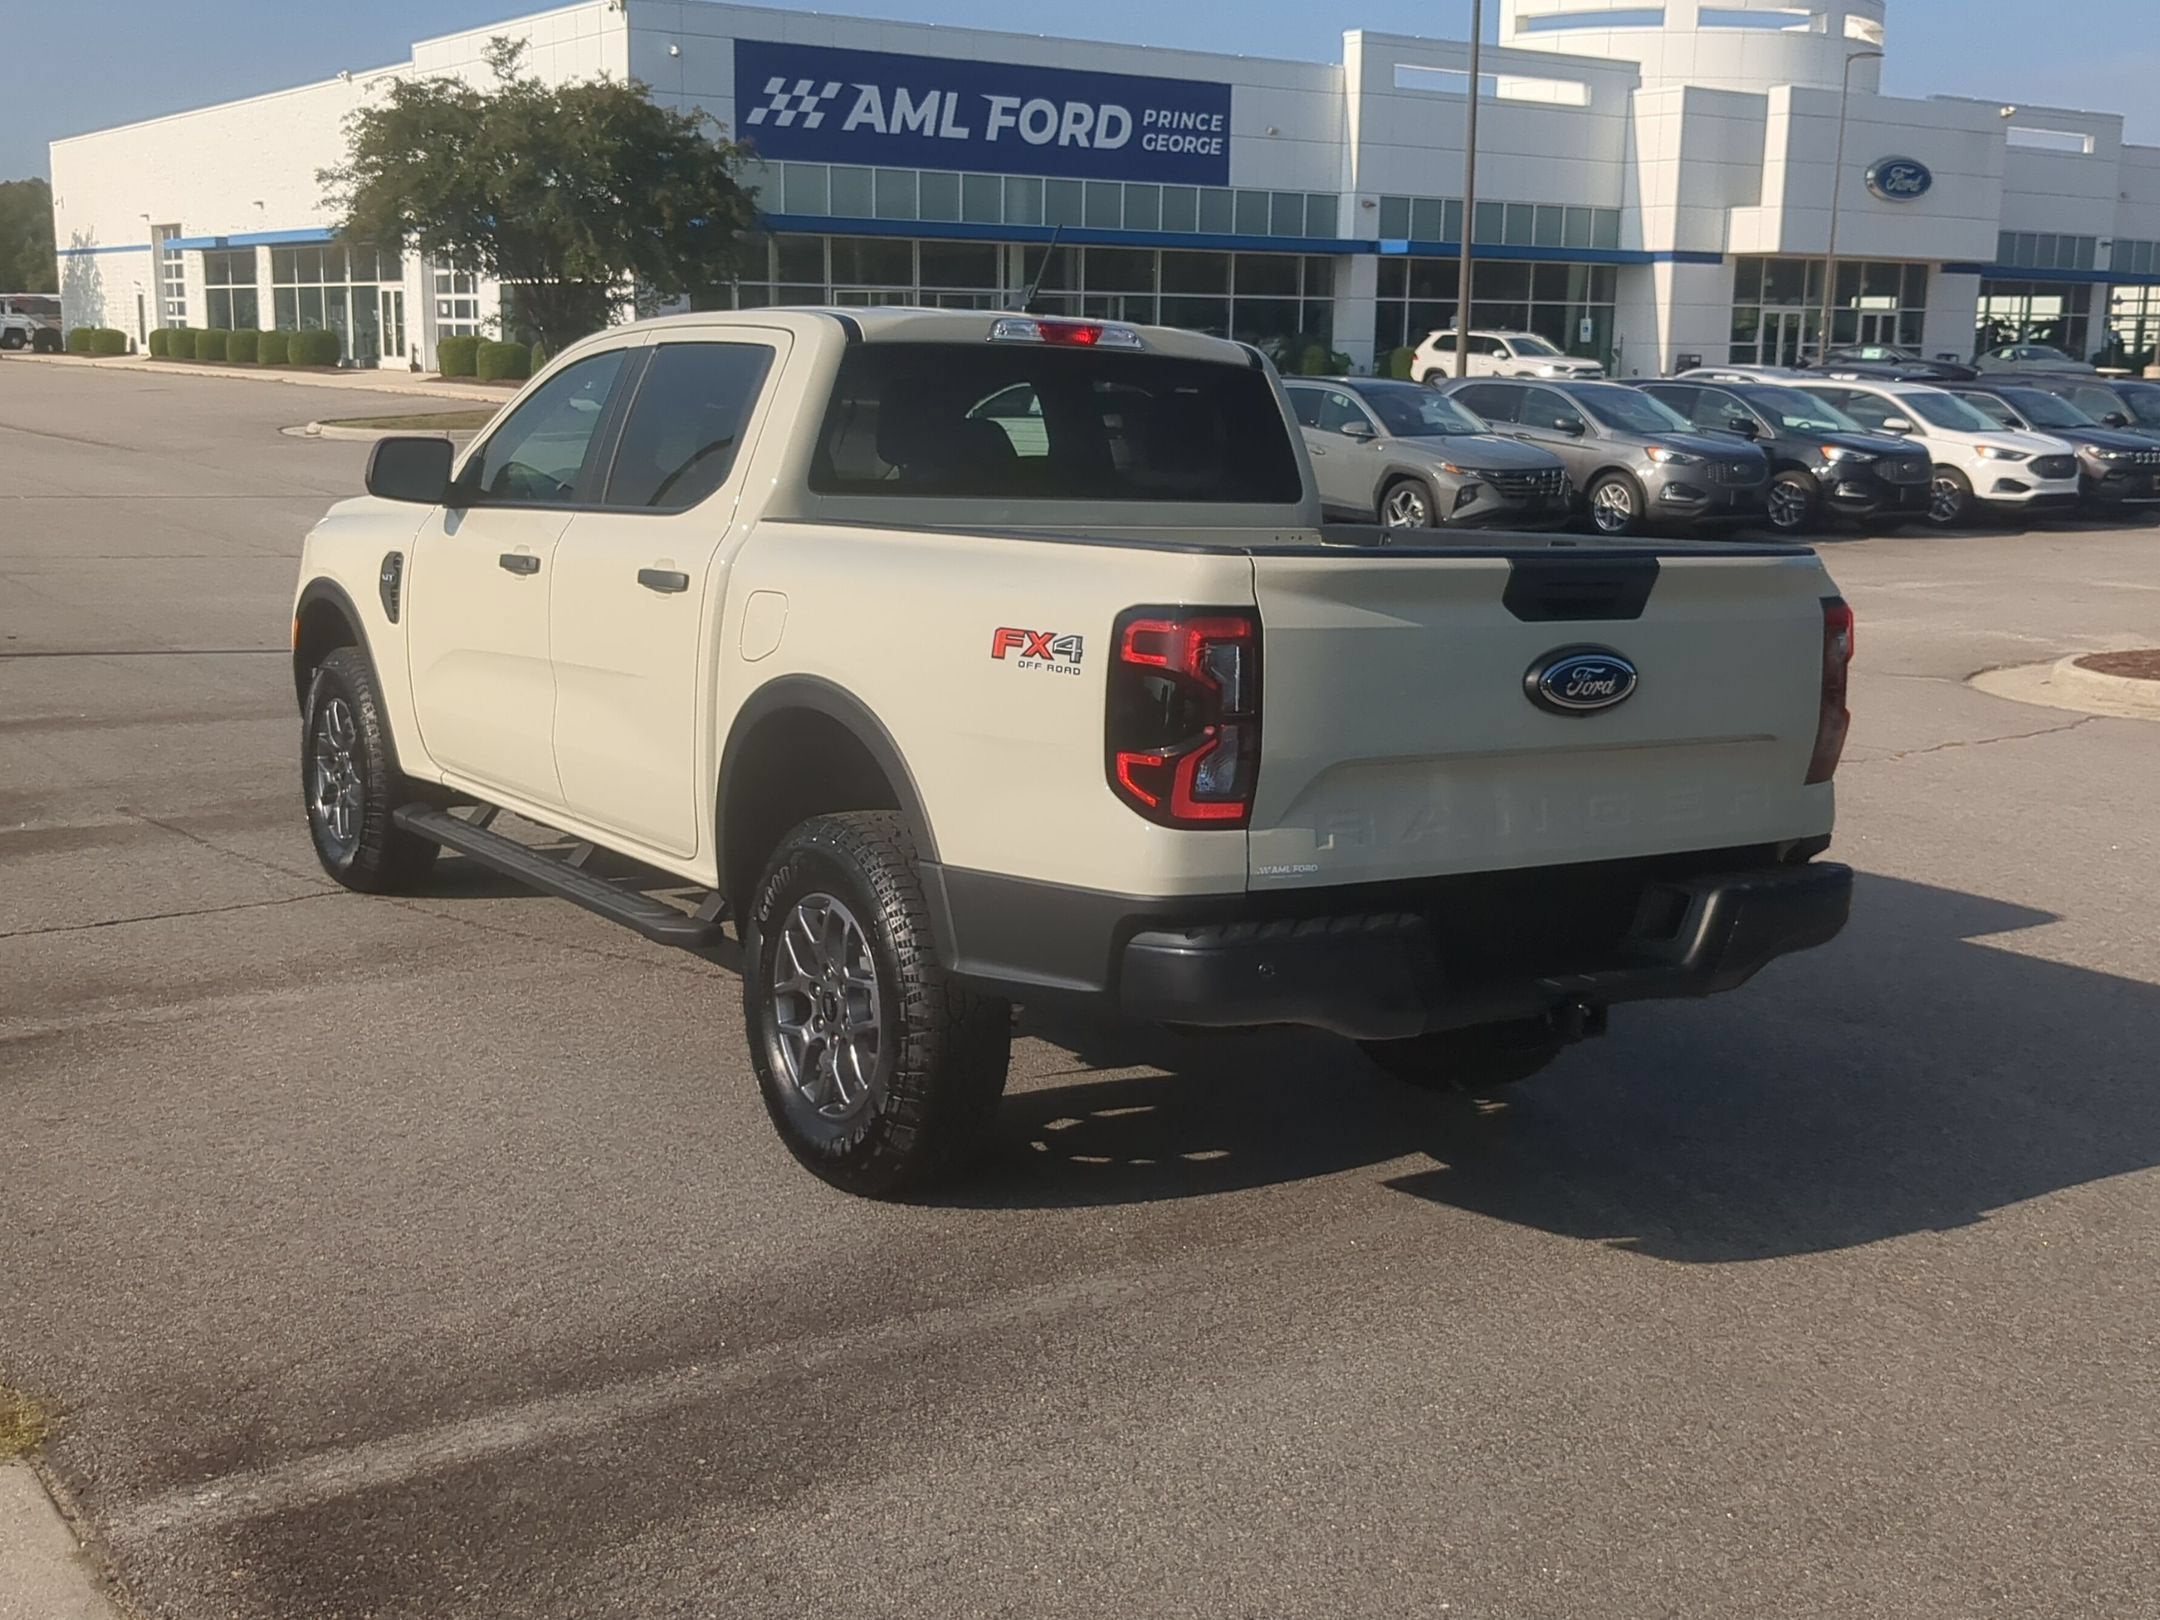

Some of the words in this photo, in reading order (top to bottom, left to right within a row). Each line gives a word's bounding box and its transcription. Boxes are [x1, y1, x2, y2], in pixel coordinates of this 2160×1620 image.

[842, 82, 970, 140] AML
[980, 93, 1134, 151] FORD
[1142, 108, 1224, 133] PRINCE
[1141, 132, 1223, 156] GEORGE
[991, 626, 1083, 664] FX4
[1018, 660, 1042, 671] OFF
[1046, 663, 1081, 676] ROAD
[1566, 665, 1618, 697] Ford
